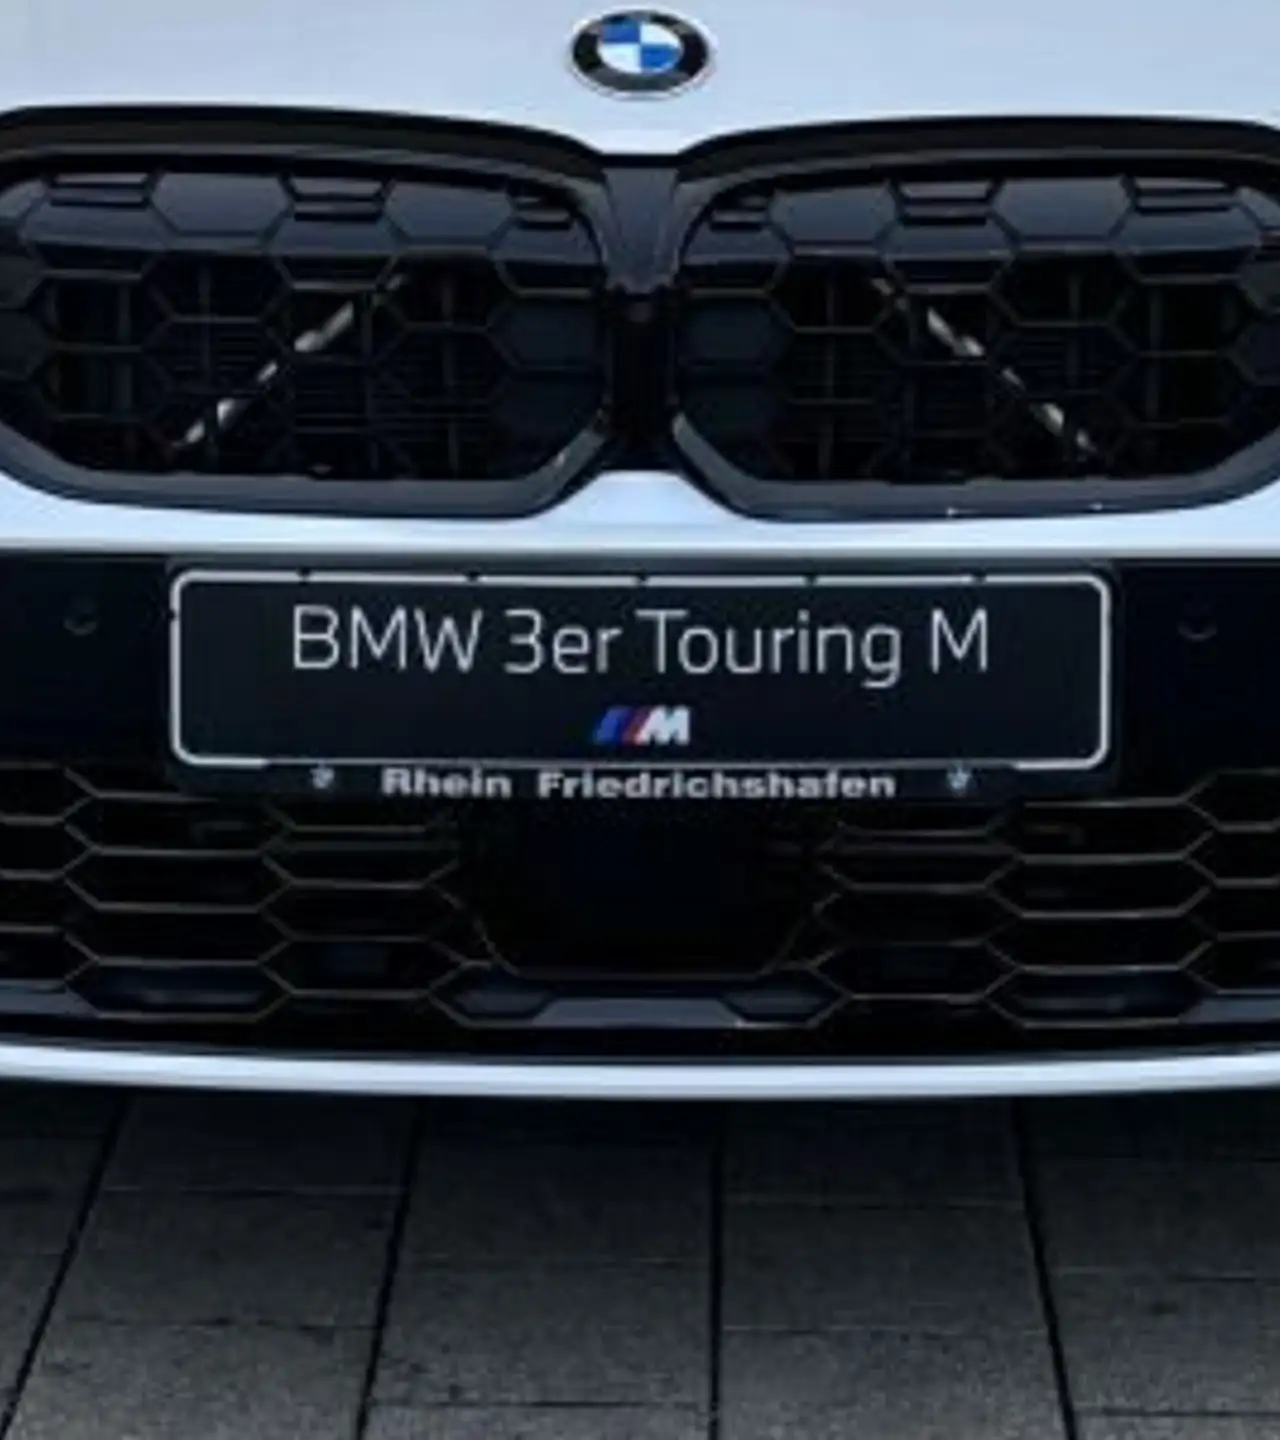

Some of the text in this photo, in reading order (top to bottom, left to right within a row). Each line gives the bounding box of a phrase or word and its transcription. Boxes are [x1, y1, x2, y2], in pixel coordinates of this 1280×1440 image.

[293, 604, 989, 689] BMW 3er Touring M
[381, 764, 898, 800] Rhein Friedrichshafen
